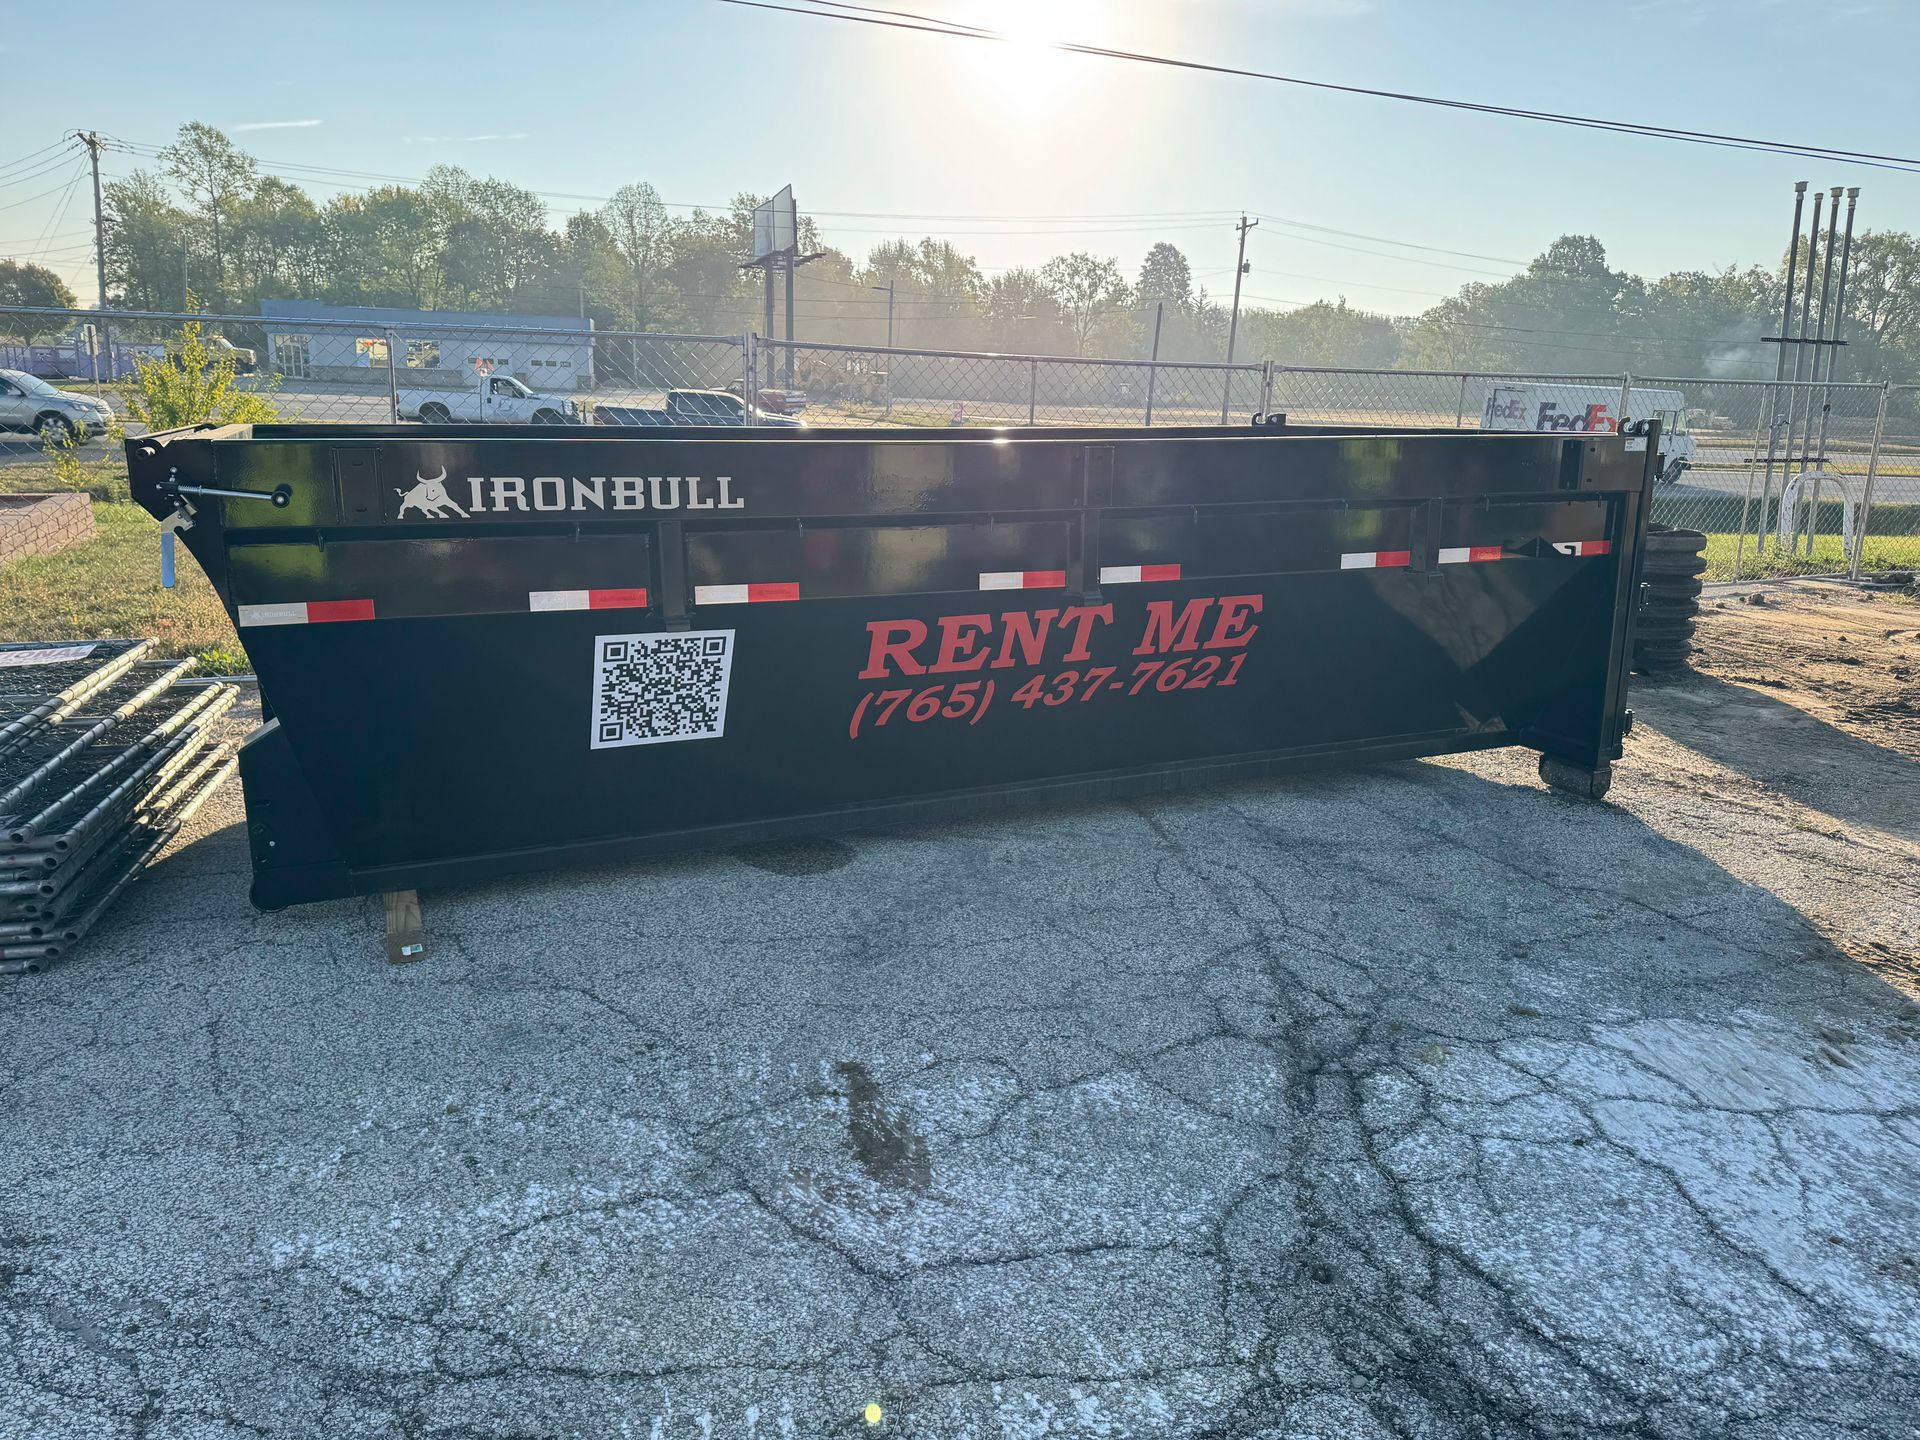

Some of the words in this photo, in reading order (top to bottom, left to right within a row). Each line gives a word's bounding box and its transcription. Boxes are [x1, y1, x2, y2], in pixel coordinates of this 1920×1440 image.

[1485, 396, 1527, 421] FedEx
[467, 476, 745, 512] IRONBULL
[0, 645, 87, 660] IONAL
[858, 603, 1114, 679] RENT
[1132, 594, 1263, 655] ME
[849, 680, 994, 739] (765)
[1010, 652, 1248, 710] 437-7621
